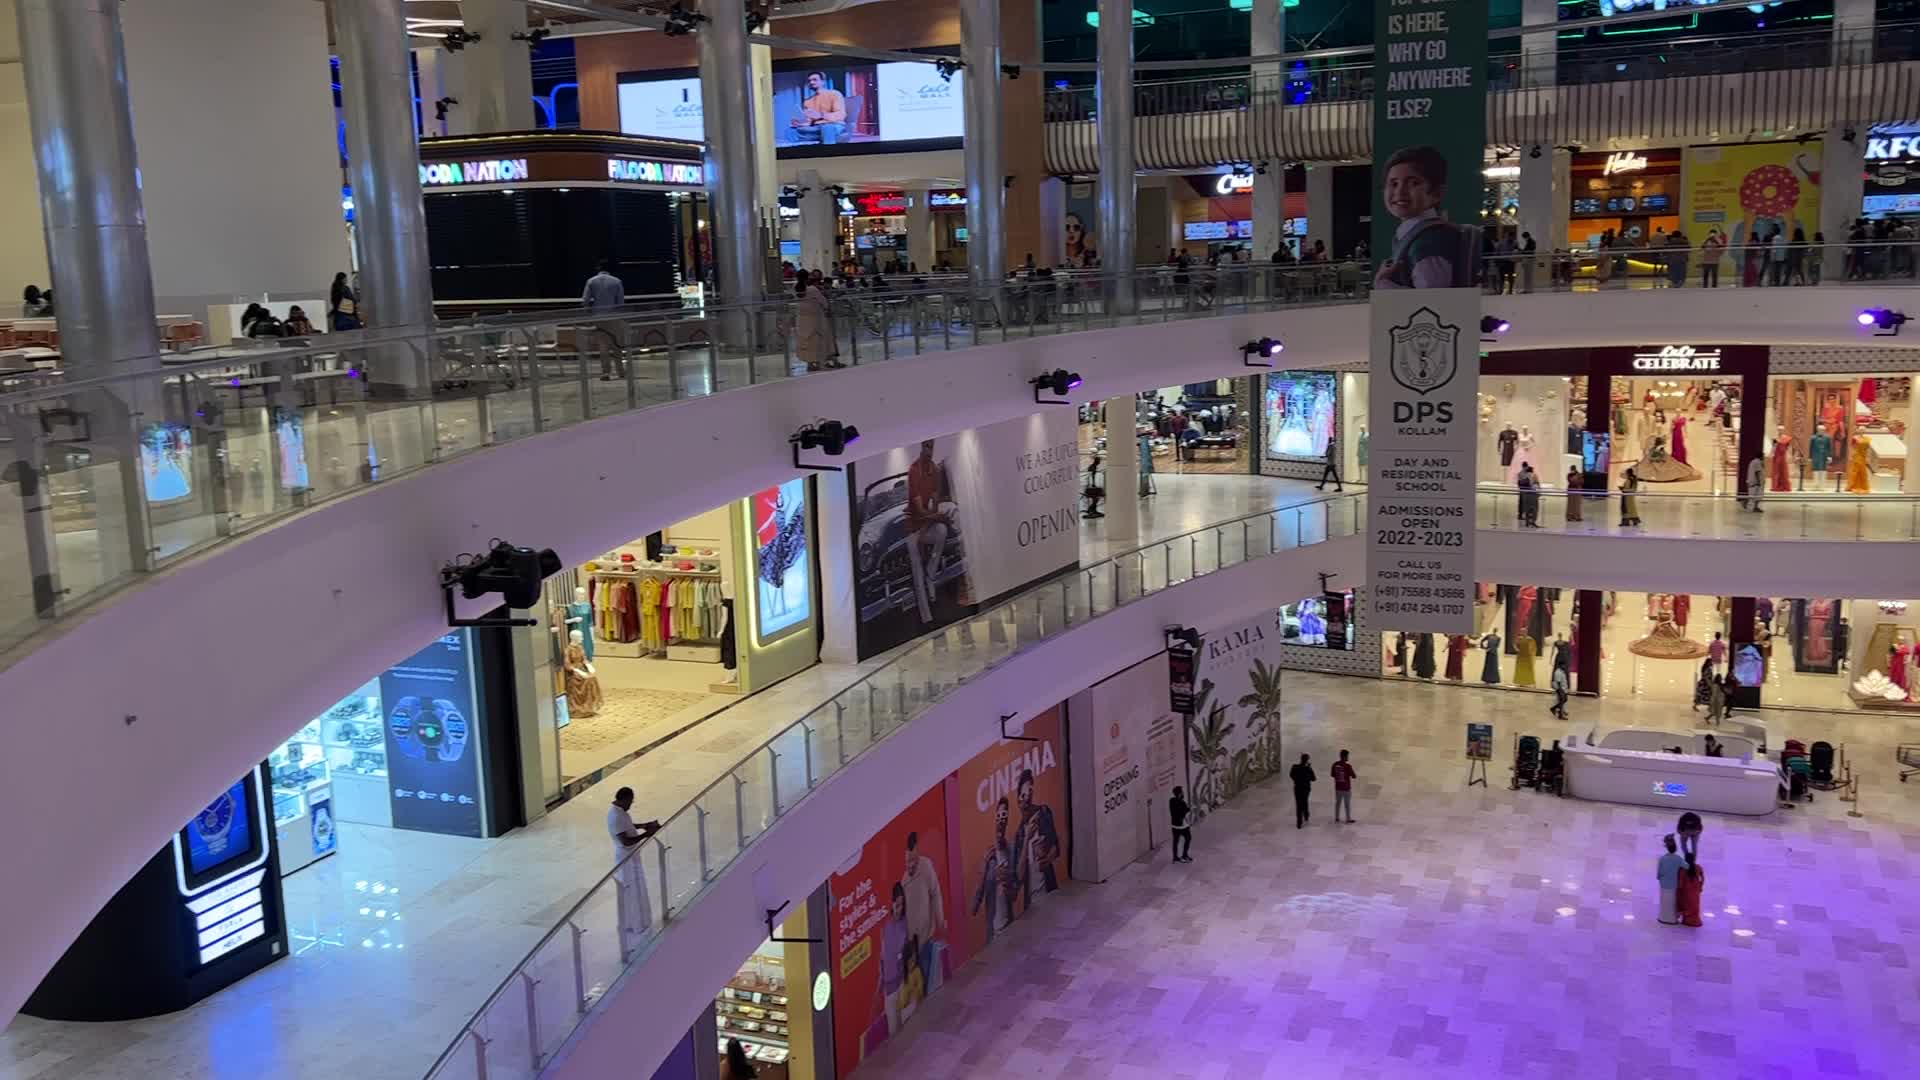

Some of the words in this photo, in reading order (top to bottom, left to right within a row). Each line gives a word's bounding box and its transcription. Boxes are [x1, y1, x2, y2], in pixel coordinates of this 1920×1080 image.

[1388, 14, 1403, 34] IS
[1406, 11, 1448, 33] HERE,
[1388, 41, 1423, 63] WHY
[1426, 39, 1447, 61] GO
[1387, 66, 1472, 92] ANYWHERE
[1387, 98, 1432, 120] ELSE?
[464, 159, 529, 182] NATION
[608, 159, 663, 182] FALOODA
[1632, 357, 1721, 369] CELEBRATE
[1393, 401, 1453, 423] DPS
[1398, 427, 1447, 436] KOLLAM
[1016, 453, 1033, 472] WE
[1035, 448, 1053, 468] ARE
[1394, 458, 1418, 467] DAY
[1423, 458, 1449, 467] AND
[1381, 470, 1462, 480] RESIDENTIAL
[1395, 482, 1447, 491] SCHOOL
[1378, 505, 1464, 517] ADMISSIONS
[1401, 518, 1440, 528] OPEN
[1377, 530, 1463, 546] 2022-2023
[1398, 560, 1425, 569] CALL
[1427, 561, 1442, 569] US
[1378, 571, 1399, 579] FOR
[1402, 572, 1433, 581] MORE
[1435, 573, 1462, 581] INFO
[1375, 585, 1399, 598] (+91)
[1375, 601, 1399, 613] (+91)
[1400, 603, 1418, 612] 474
[1209, 626, 1264, 659] KAMA
[976, 740, 1056, 813] CINEMA
[1104, 764, 1140, 797] OPENING
[1104, 789, 1129, 814] SOON
[840, 891, 855, 912] For
[855, 878, 873, 900] the
[840, 931, 856, 952] the
